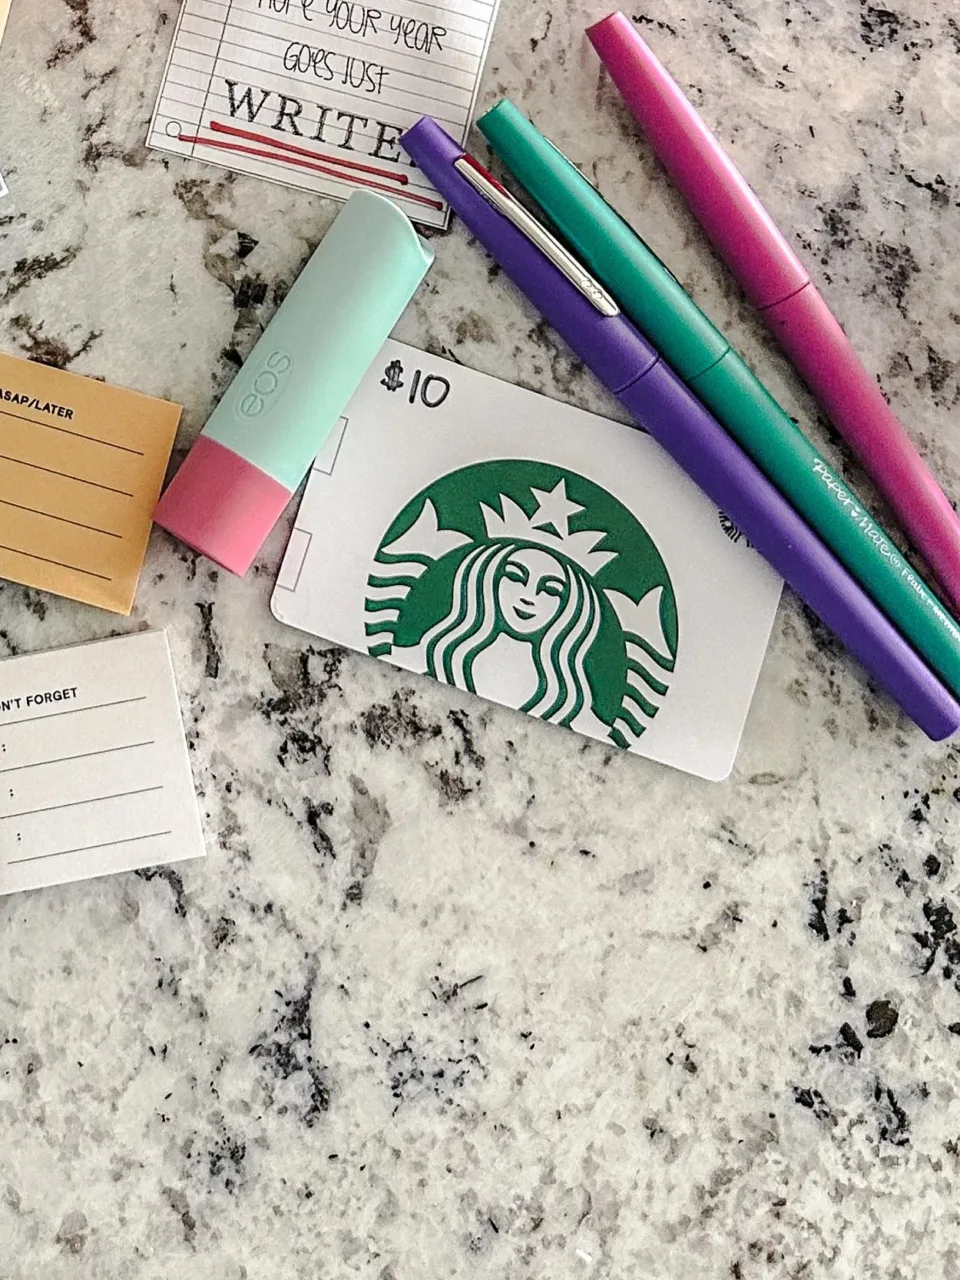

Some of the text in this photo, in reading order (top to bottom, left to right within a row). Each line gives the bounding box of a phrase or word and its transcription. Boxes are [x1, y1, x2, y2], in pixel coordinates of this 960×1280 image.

[341, 56, 390, 94] JUST
[224, 78, 417, 168] WRITE
[380, 359, 450, 408] $10
[25, 687, 78, 707] FORGET
